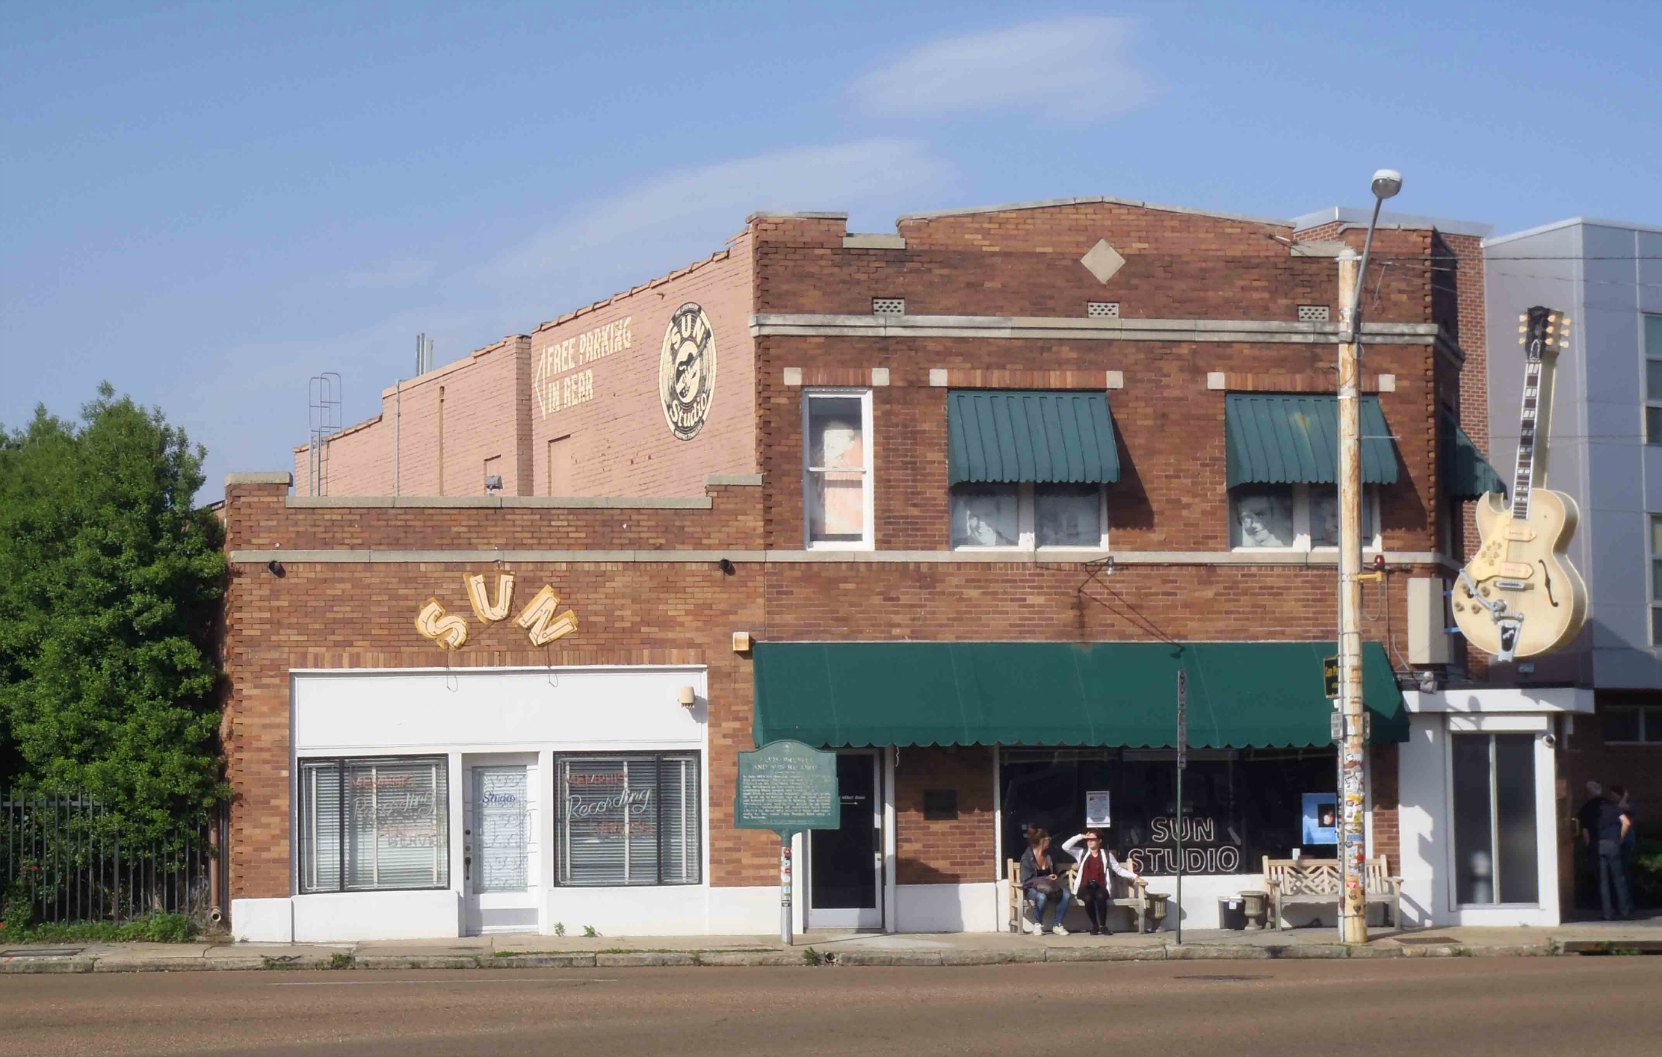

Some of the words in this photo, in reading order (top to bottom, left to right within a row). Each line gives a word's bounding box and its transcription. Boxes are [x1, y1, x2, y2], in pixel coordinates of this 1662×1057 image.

[547, 338, 576, 377] FREE
[579, 317, 632, 366] PARKING
[671, 314, 706, 350] SUN
[548, 380, 560, 414] IN
[564, 368, 594, 408] REAR
[670, 393, 707, 427] Studio
[416, 571, 578, 651] SUN
[569, 788, 652, 817] Recording
[1151, 817, 1214, 843] SUN
[1127, 846, 1239, 873] STUDIO
